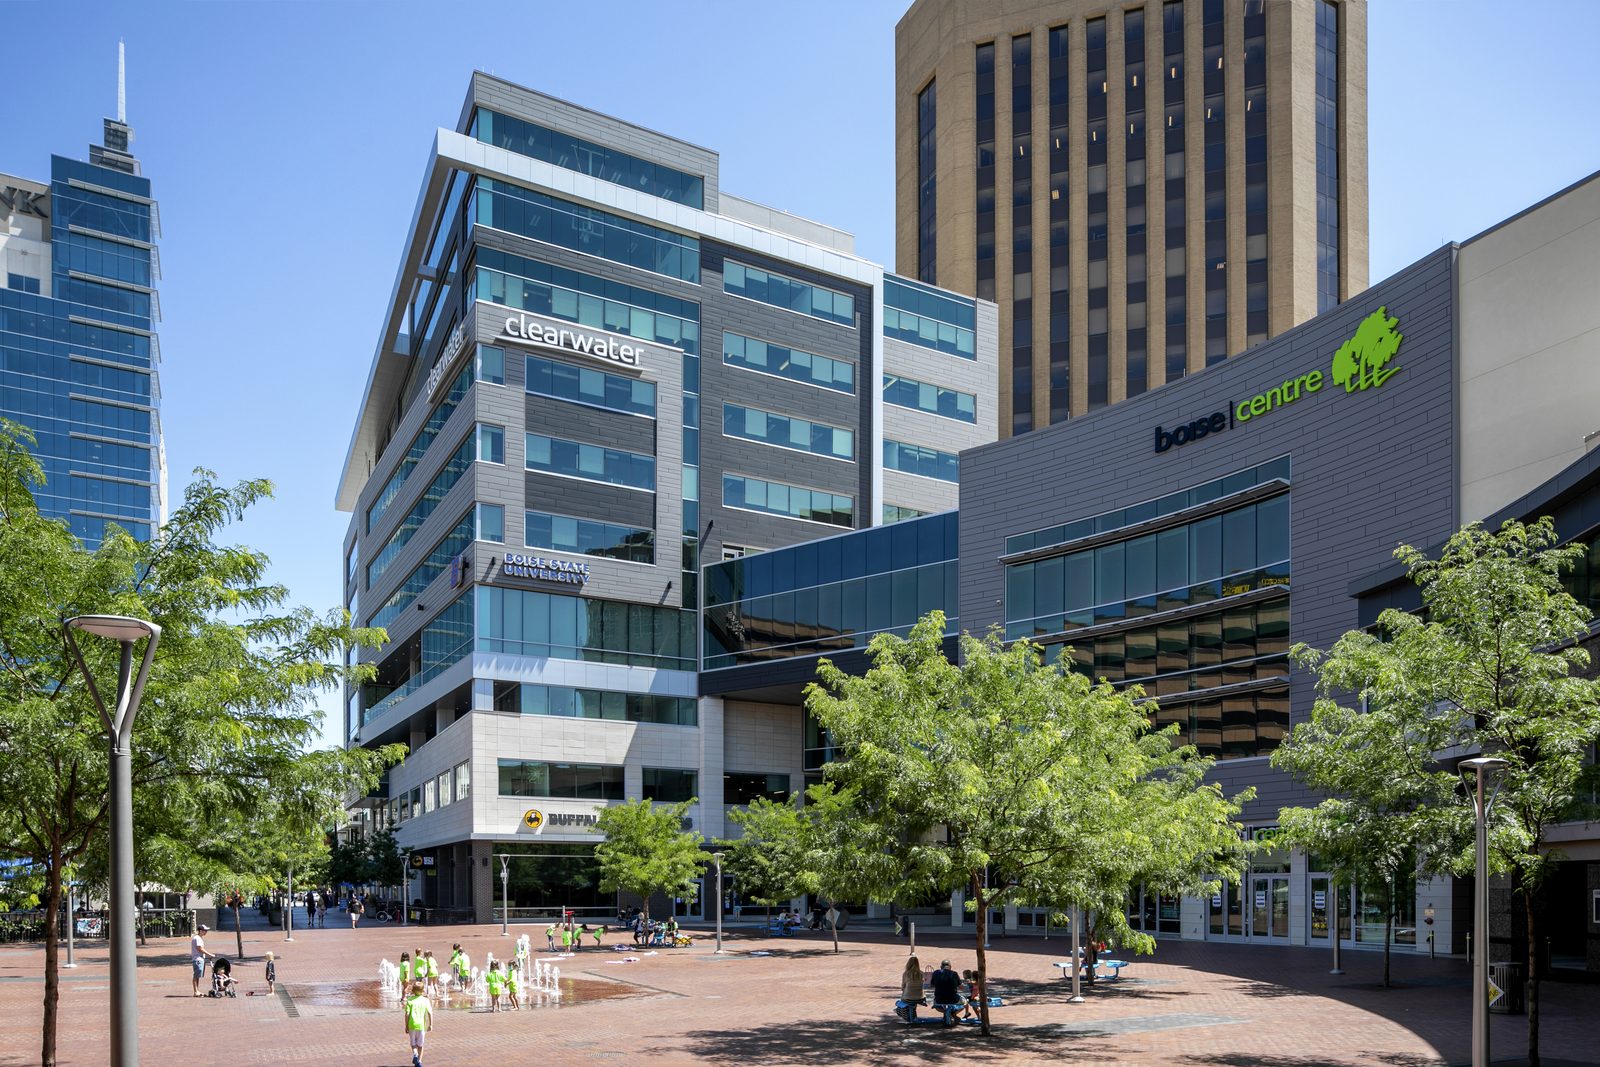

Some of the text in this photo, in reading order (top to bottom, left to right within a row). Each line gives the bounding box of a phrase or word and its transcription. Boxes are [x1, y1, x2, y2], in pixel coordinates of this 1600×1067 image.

[505, 314, 645, 365] clearwater
[1154, 369, 1323, 453] boise centre
[504, 553, 590, 575] BOISE STATE
[504, 564, 591, 585] UNIVERSITY
[548, 813, 597, 827] BUFFAL
